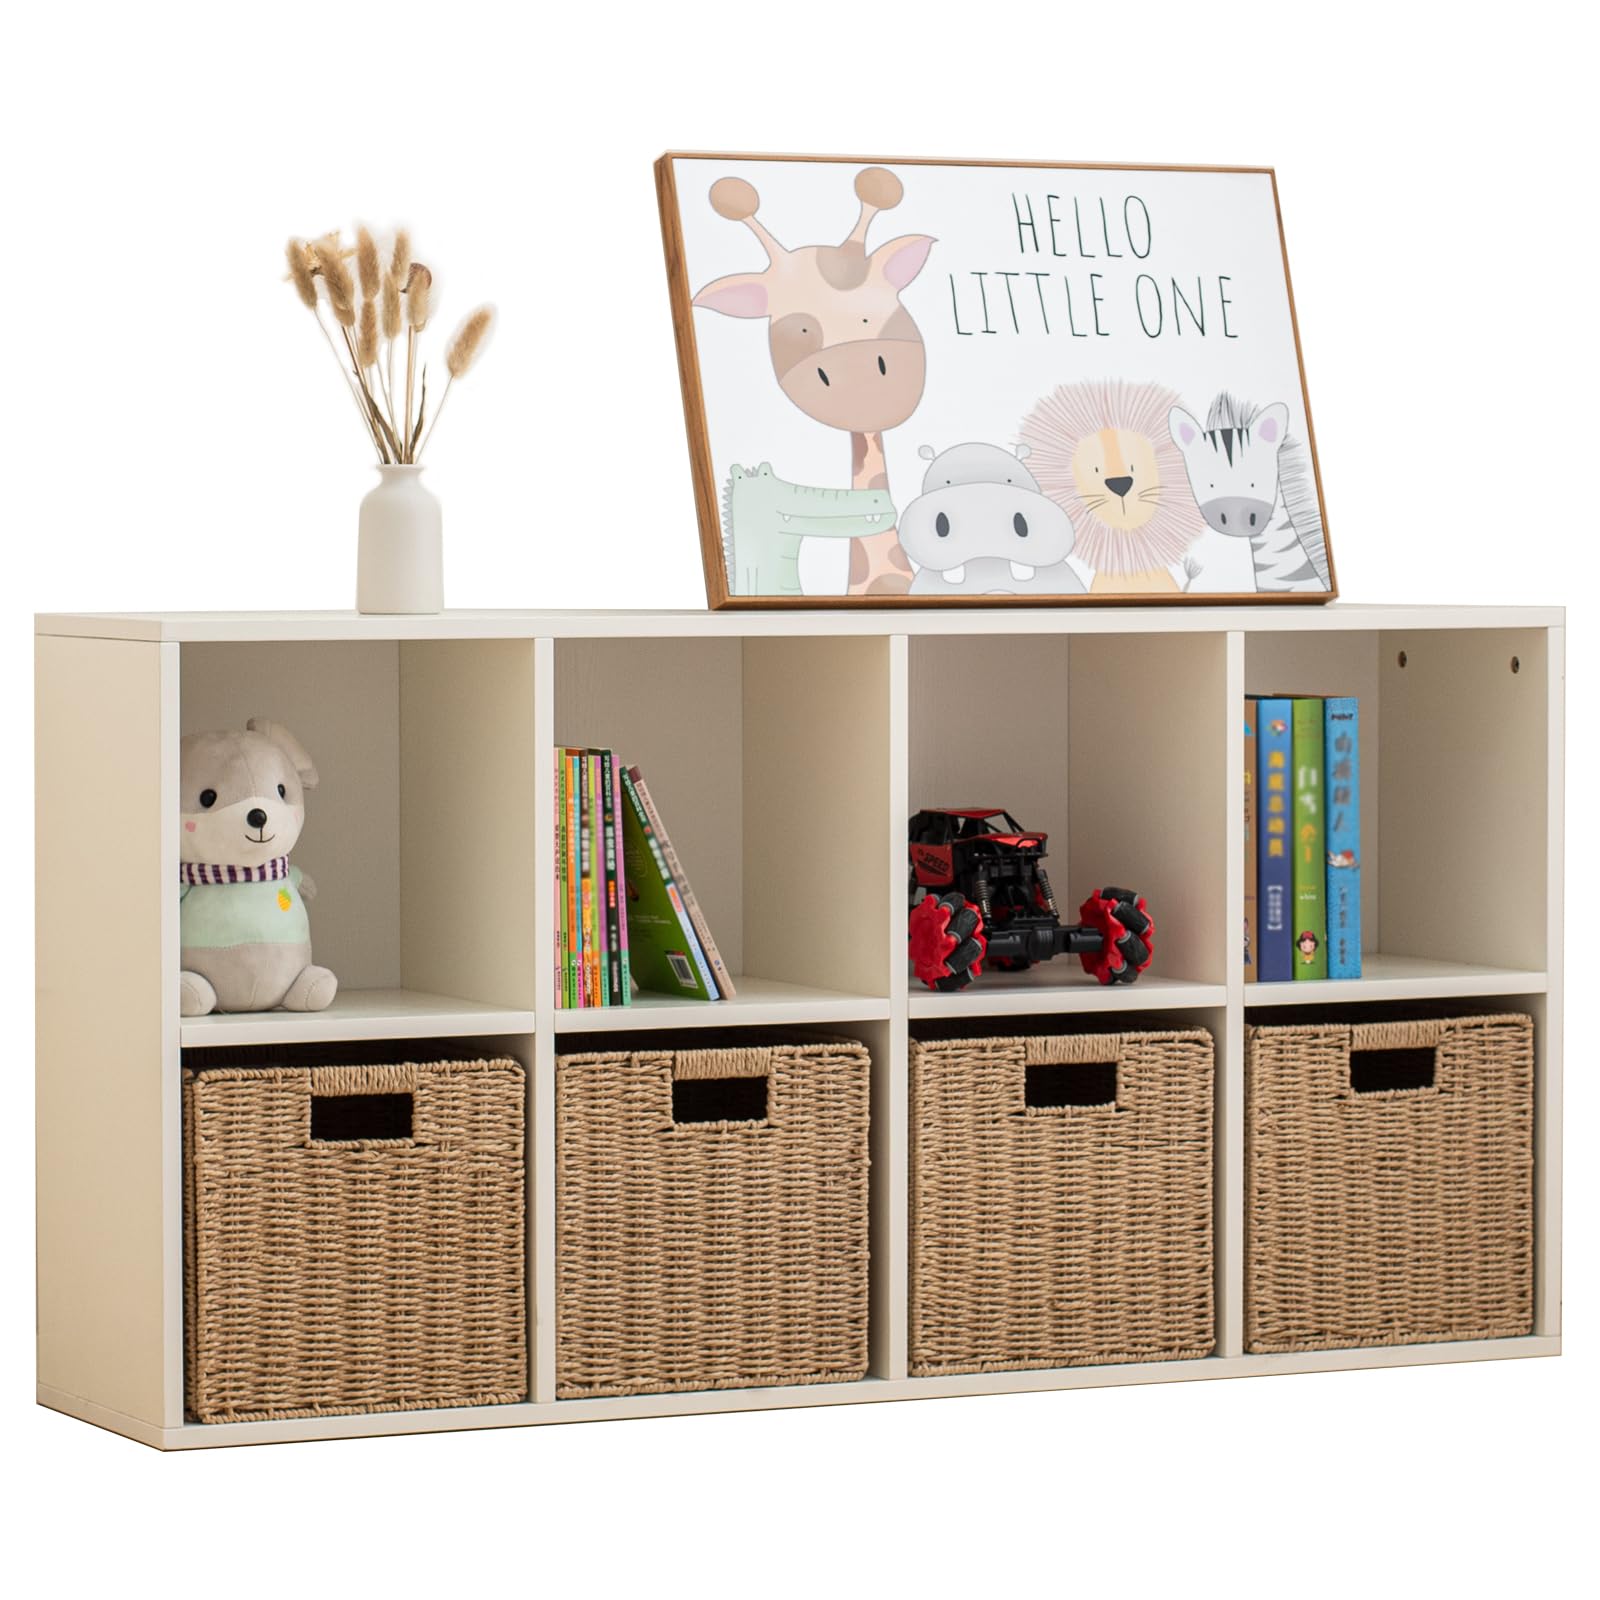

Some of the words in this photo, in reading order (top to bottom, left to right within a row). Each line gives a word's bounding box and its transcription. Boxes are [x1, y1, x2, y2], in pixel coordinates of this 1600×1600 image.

[1012, 192, 1151, 259] HELLO
[949, 271, 1110, 337] LITTLE
[1135, 274, 1239, 338] ONE
